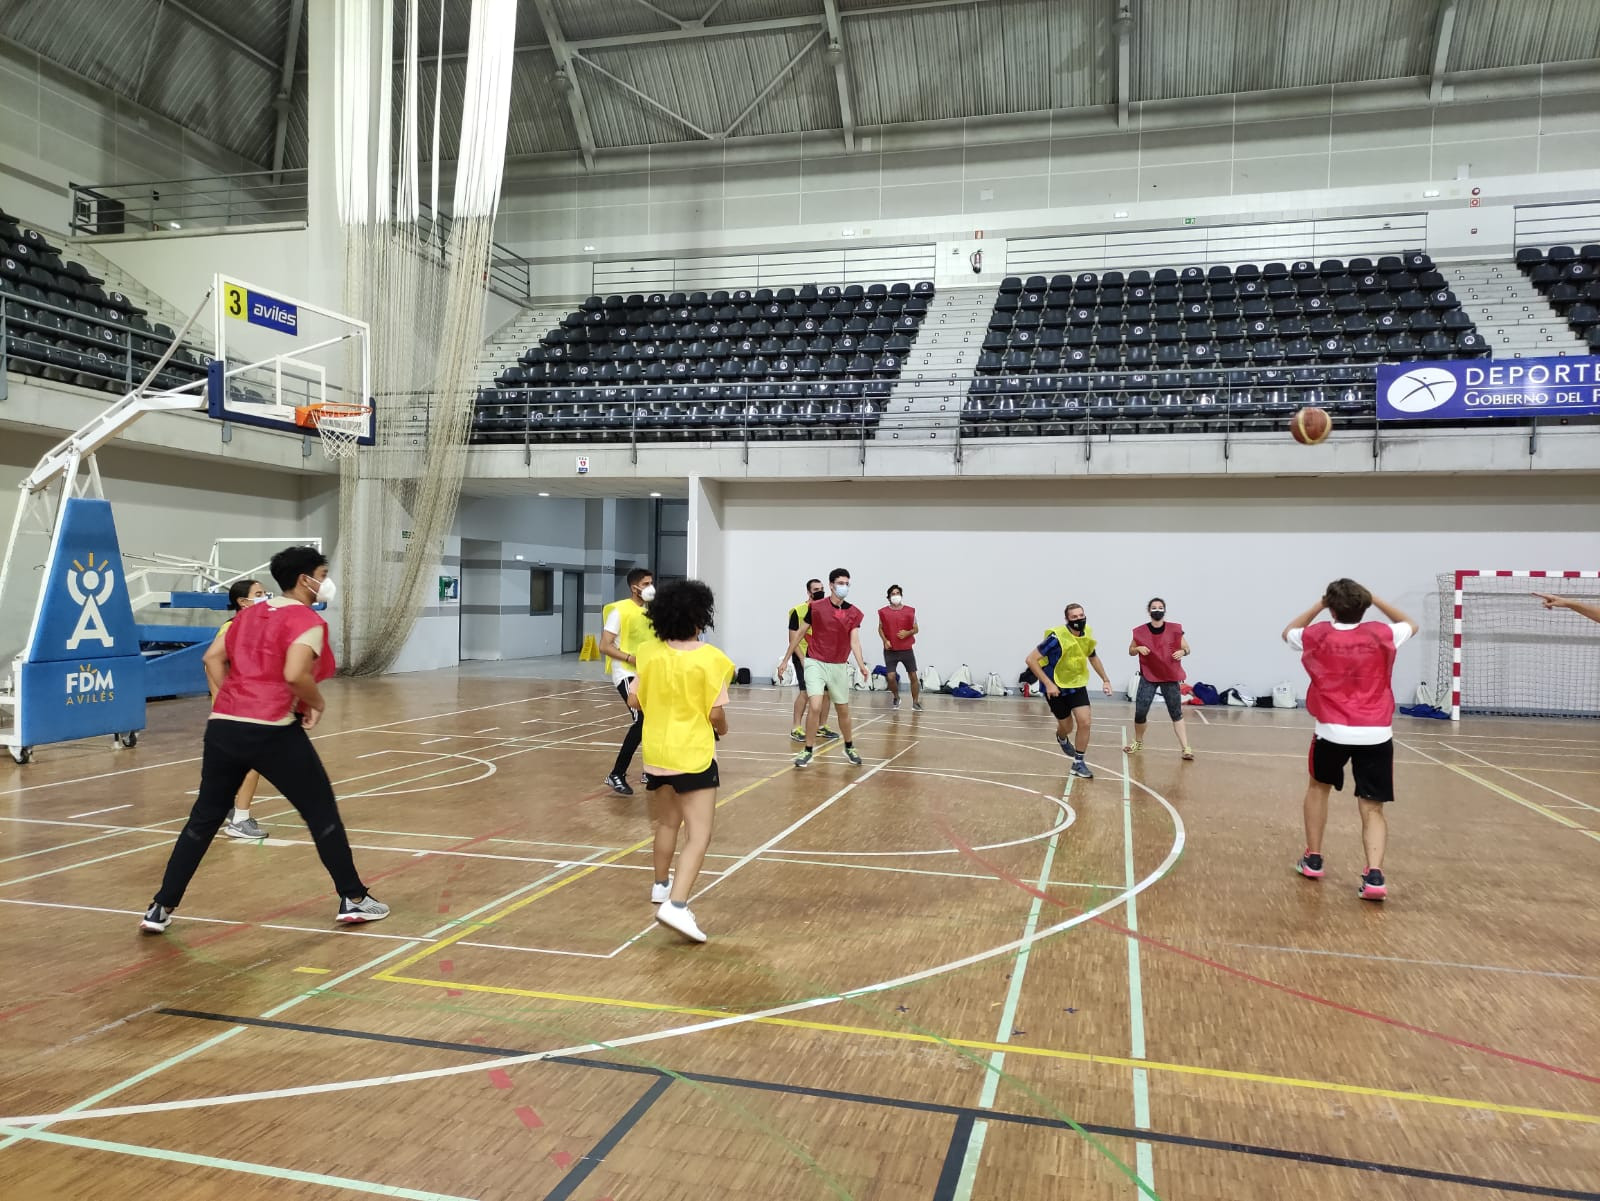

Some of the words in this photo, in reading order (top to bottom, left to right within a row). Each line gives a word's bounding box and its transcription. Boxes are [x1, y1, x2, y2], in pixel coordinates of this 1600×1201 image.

[230, 290, 242, 316] 3
[254, 303, 297, 326] avilés
[1464, 391, 1550, 406] GOBIERNO
[1556, 391, 1585, 404] DEL
[66, 670, 114, 693] FDM
[66, 692, 115, 705] AVILÉS
